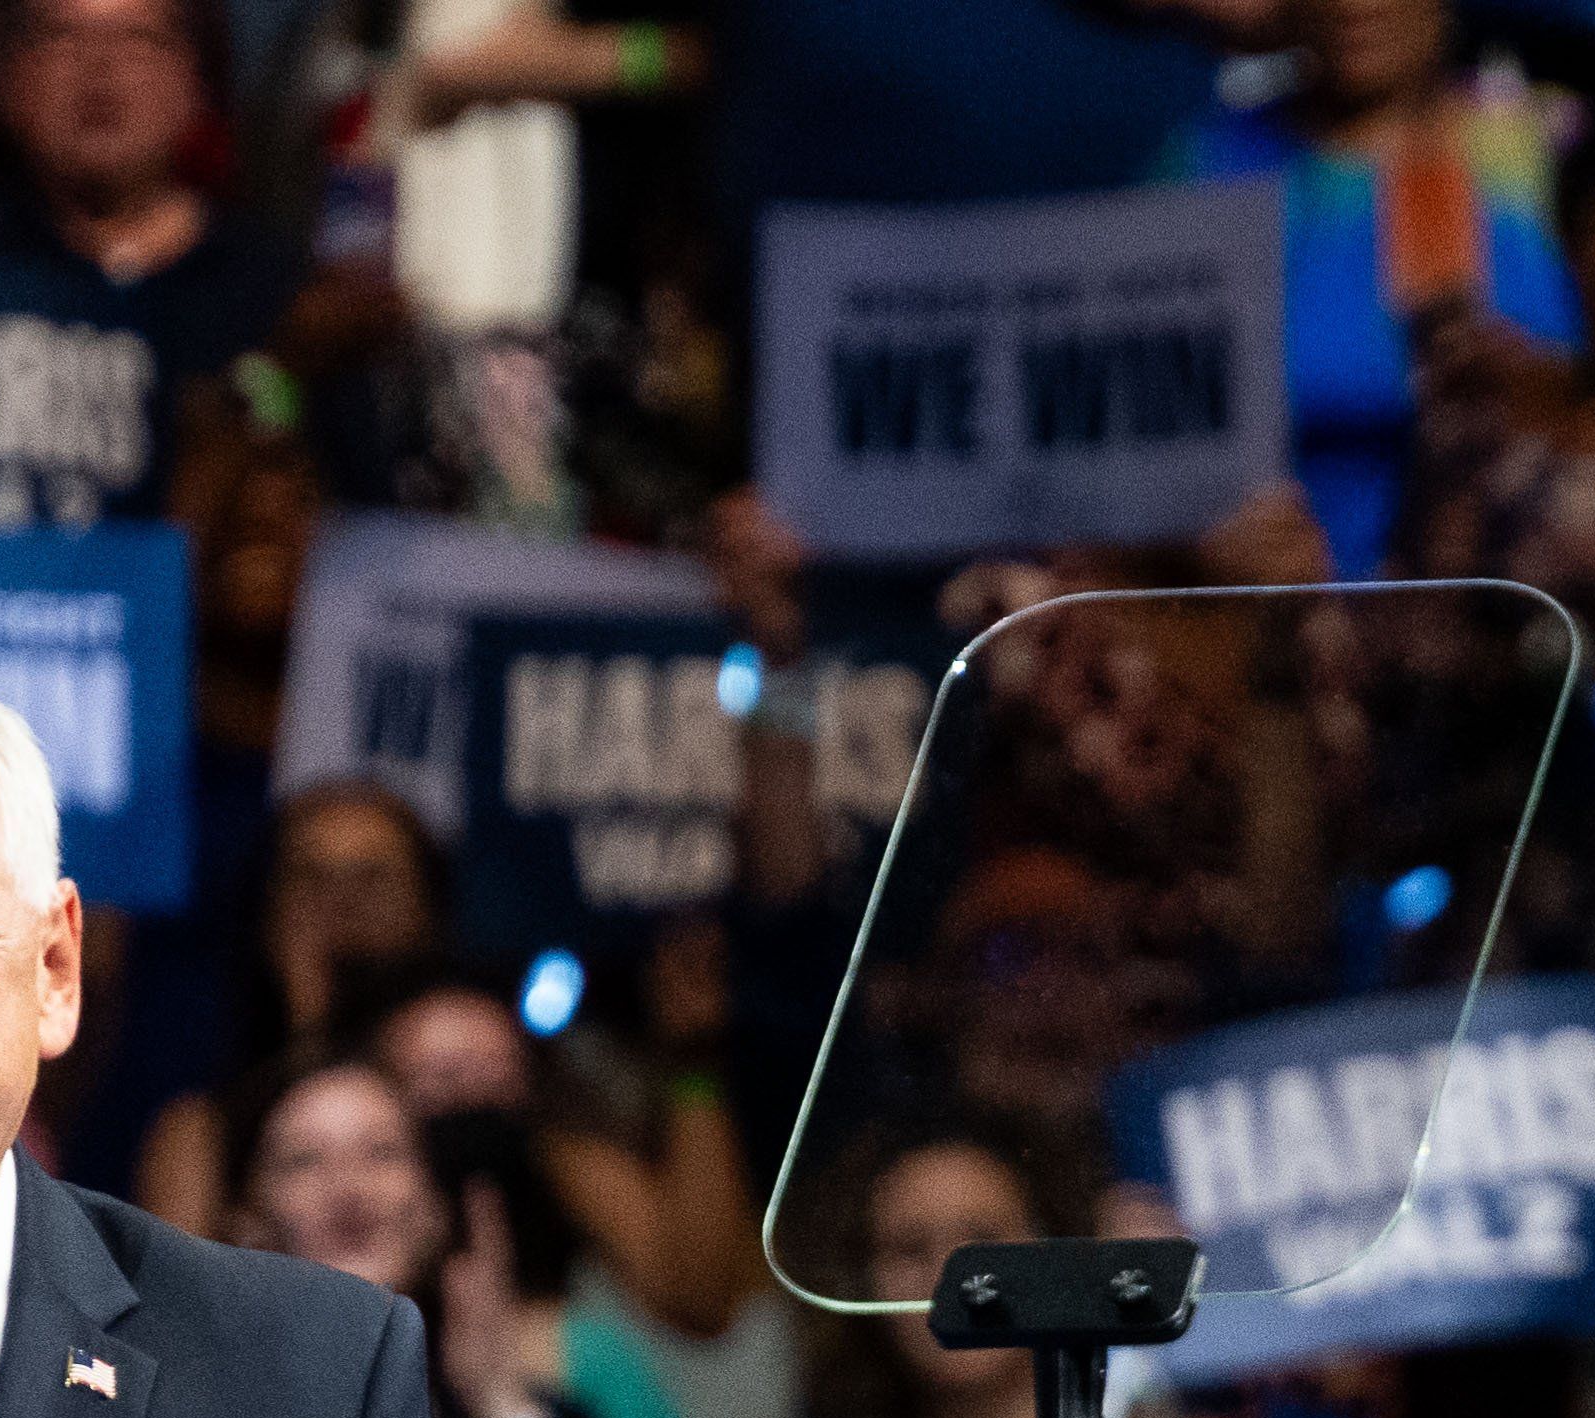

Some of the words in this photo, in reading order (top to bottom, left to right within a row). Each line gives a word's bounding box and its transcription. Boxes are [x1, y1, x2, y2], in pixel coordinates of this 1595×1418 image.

[832, 335, 978, 458] WE
[1021, 318, 1232, 448] WIN
[502, 650, 934, 822] HARIS
[1264, 1182, 1592, 1308] WALZ
